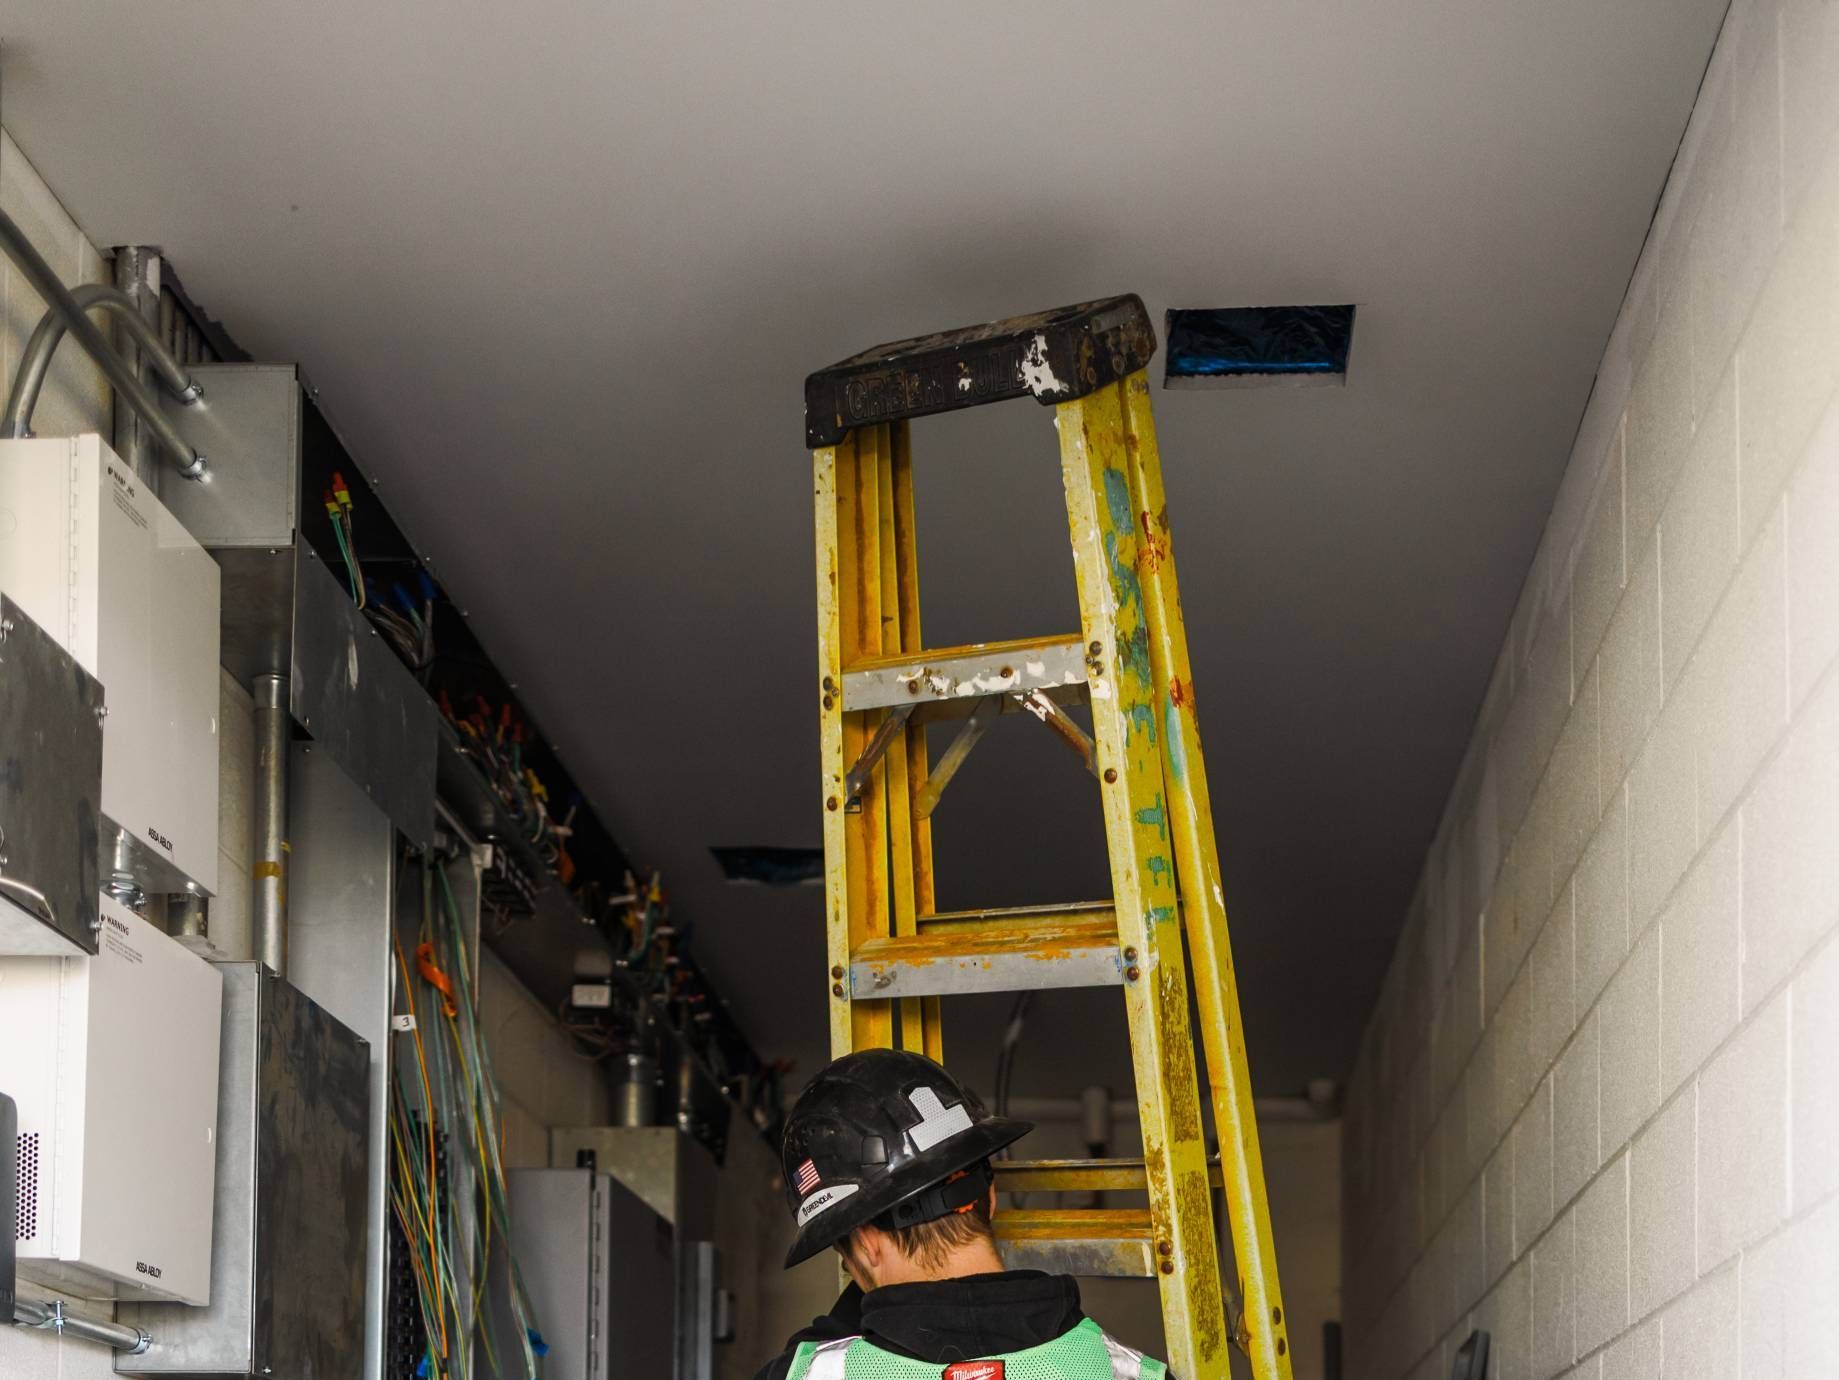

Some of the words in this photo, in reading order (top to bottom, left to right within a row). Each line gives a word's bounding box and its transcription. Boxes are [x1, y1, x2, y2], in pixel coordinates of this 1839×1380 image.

[848, 367, 944, 420] GREEN
[952, 347, 1030, 402] BULL
[148, 827, 160, 844] ASSA
[107, 914, 129, 936] WARNING
[136, 1261, 148, 1274] ASSA
[148, 1265, 162, 1279] ABLOY
